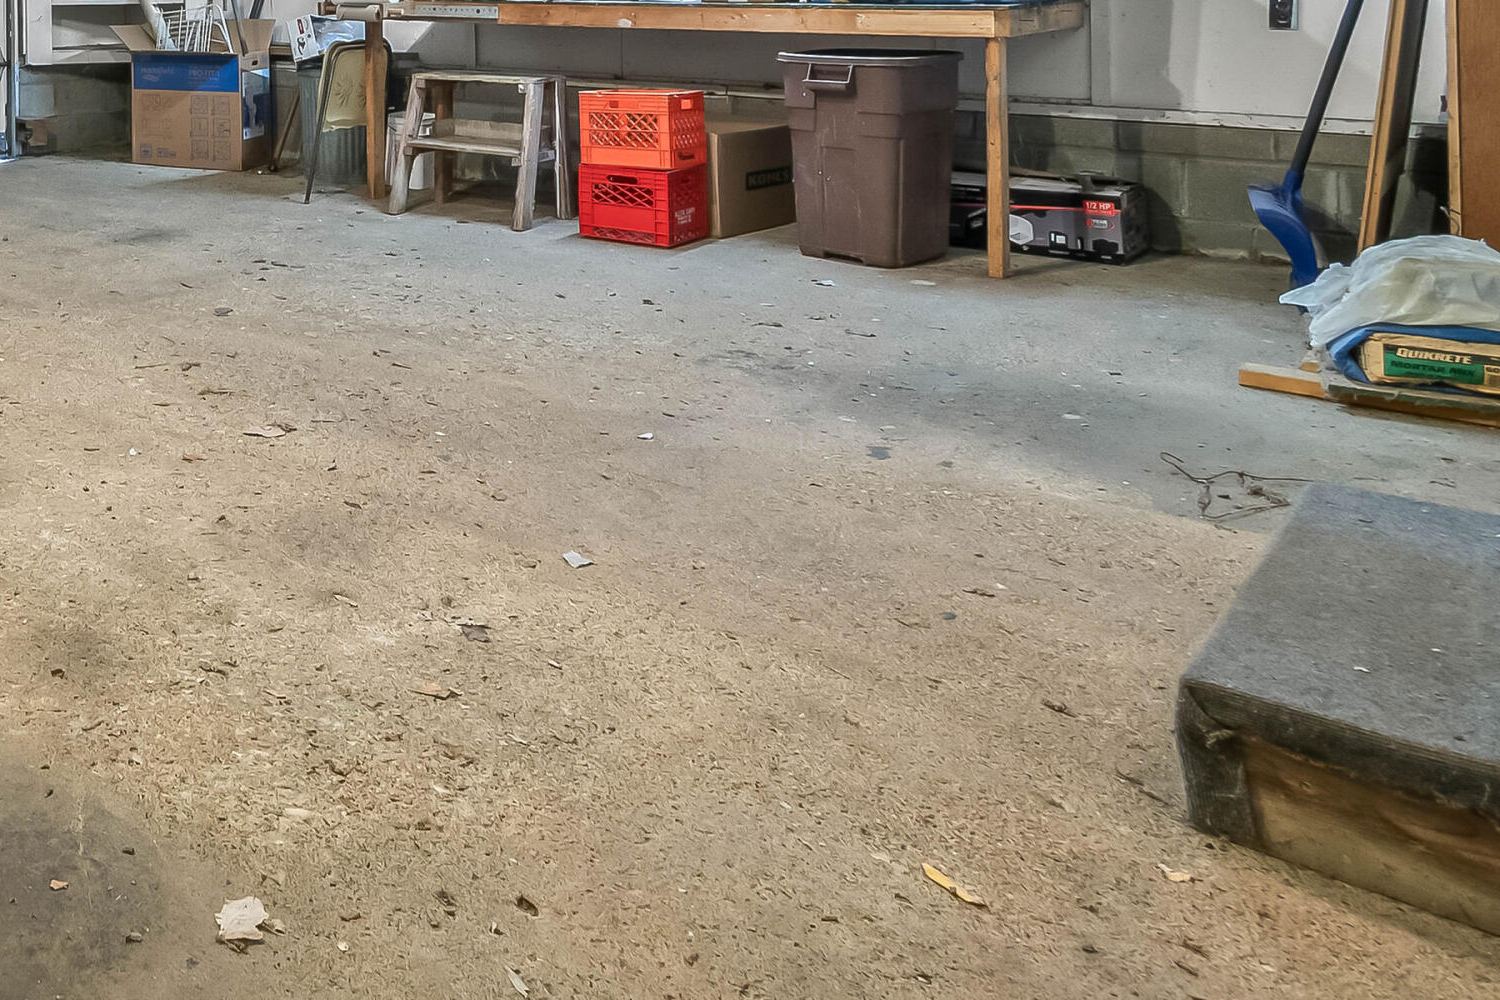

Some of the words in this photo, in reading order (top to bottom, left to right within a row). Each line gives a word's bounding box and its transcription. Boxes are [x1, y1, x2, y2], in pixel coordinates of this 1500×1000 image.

[1086, 201, 1097, 210] 1/2
[1099, 202, 1111, 211] HP
[1396, 347, 1472, 365] QUIKRETE
